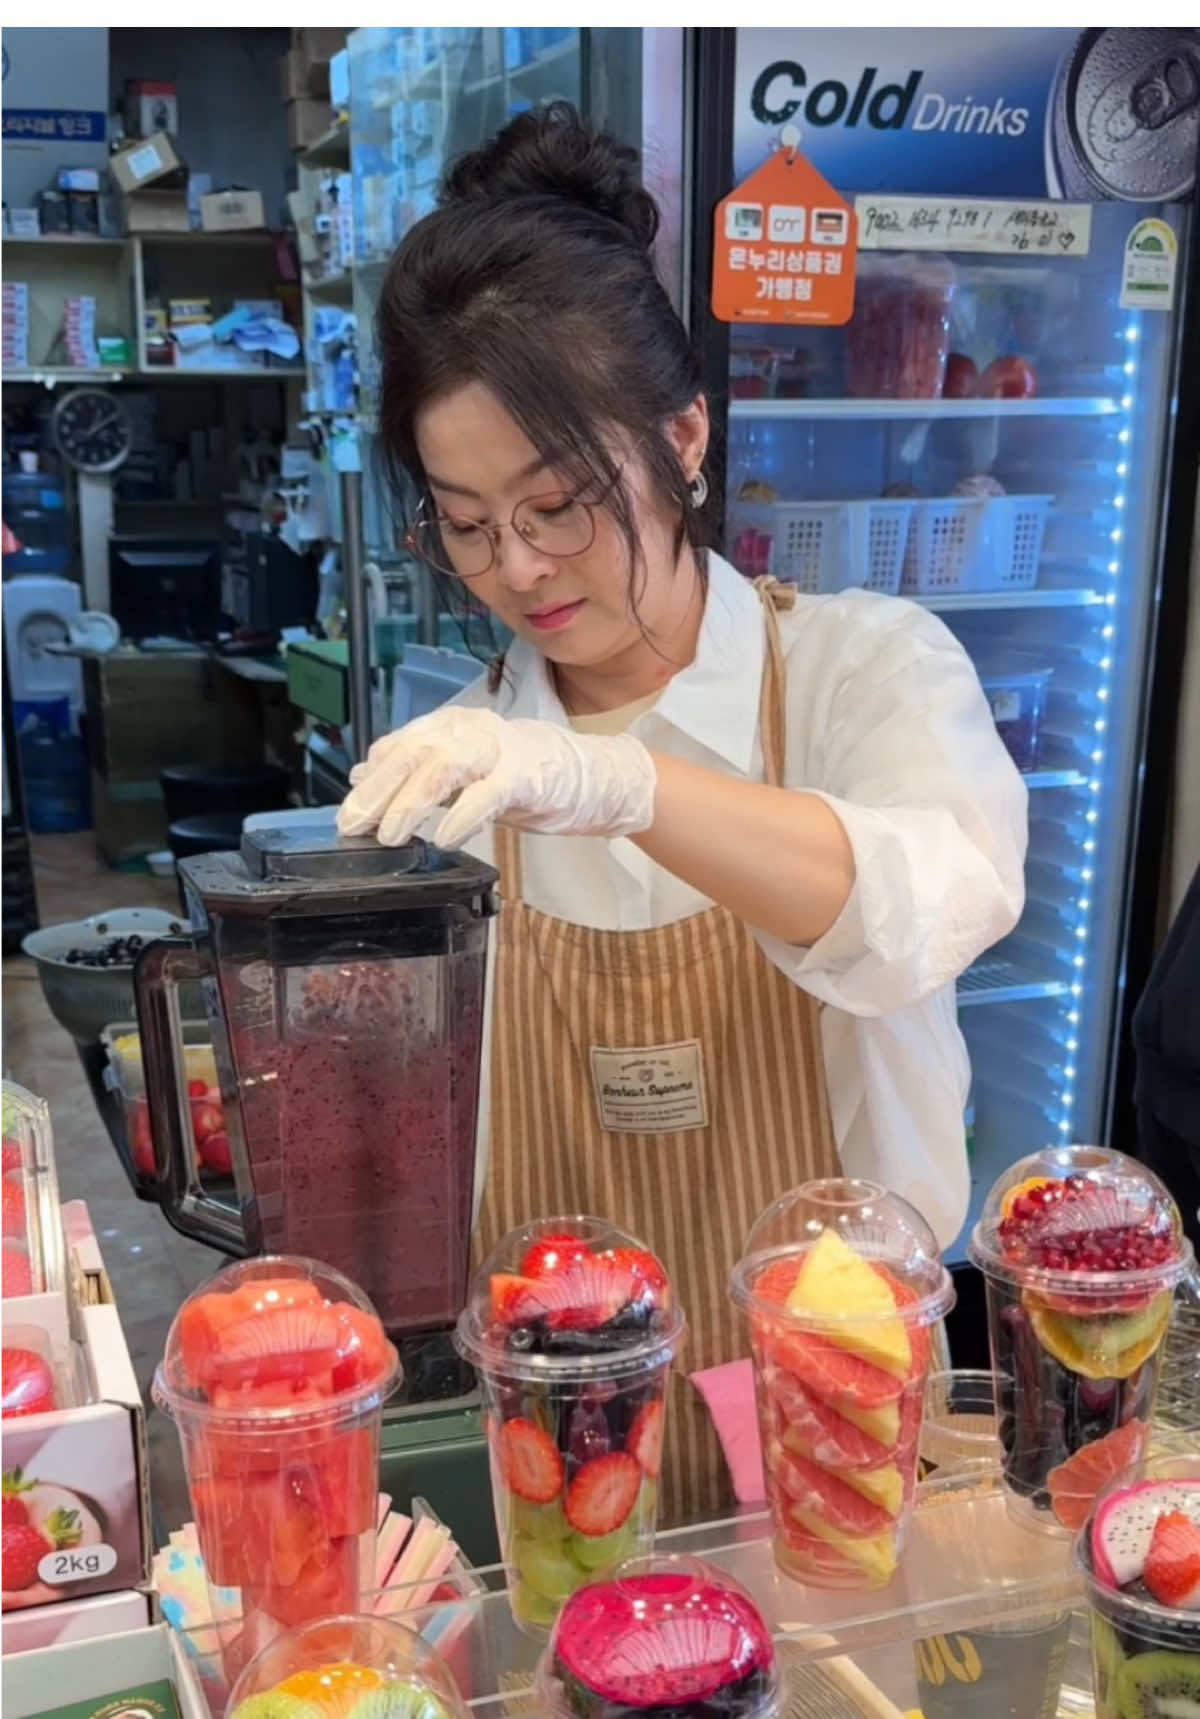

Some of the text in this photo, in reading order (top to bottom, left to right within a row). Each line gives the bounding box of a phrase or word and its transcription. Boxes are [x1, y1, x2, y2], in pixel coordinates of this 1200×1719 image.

[750, 60, 1029, 136] Cold Drinks
[55, 1555, 99, 1574] 2kg
